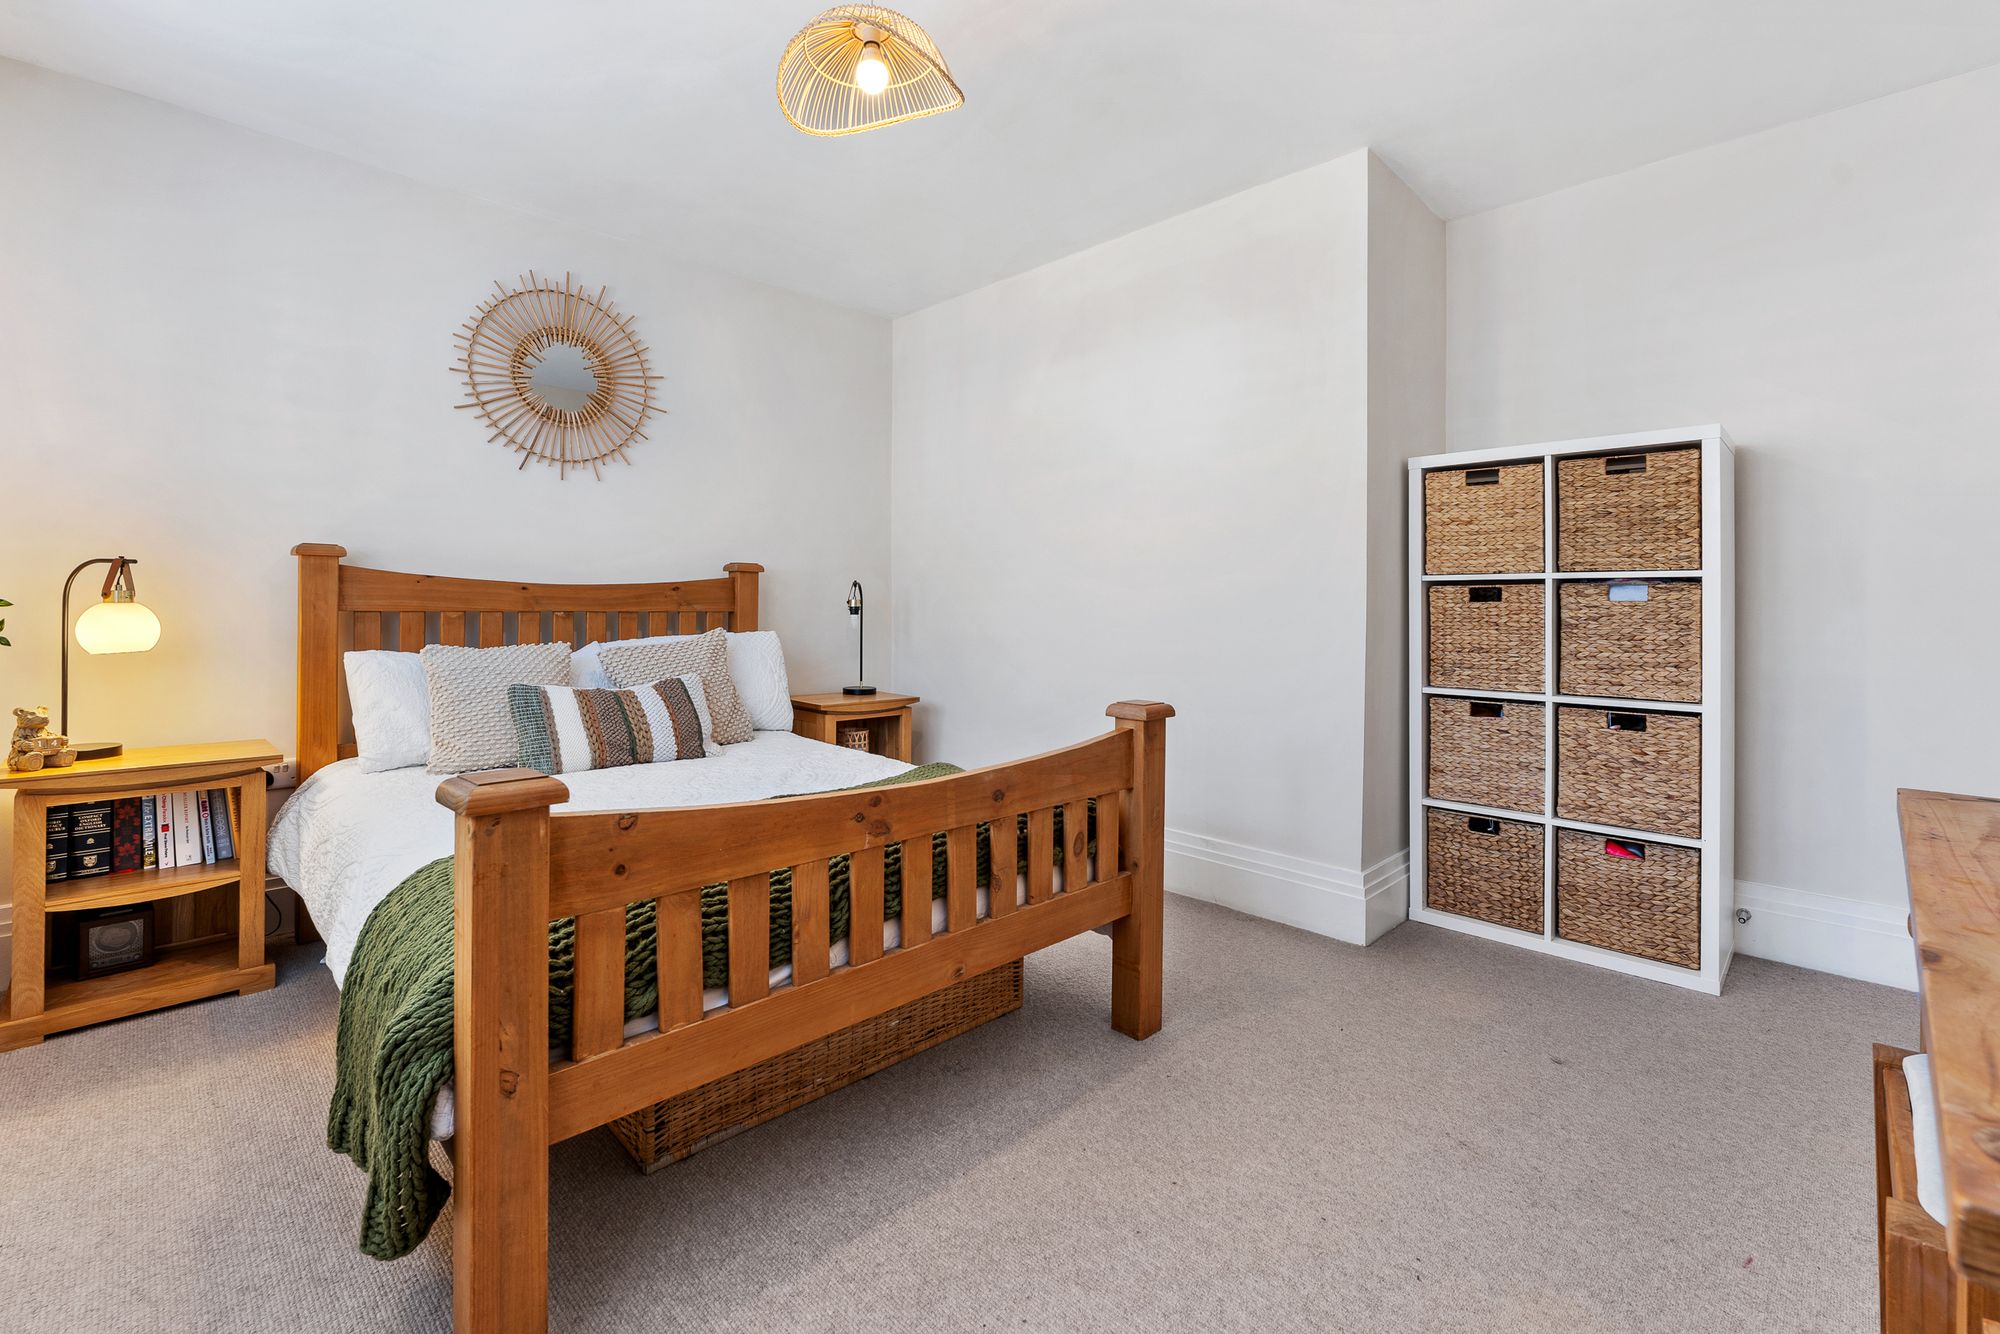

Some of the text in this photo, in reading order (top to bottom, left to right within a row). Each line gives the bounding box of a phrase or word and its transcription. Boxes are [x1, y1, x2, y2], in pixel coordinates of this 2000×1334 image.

[143, 801, 153, 813] The
[144, 815, 153, 838] EXTRA
[144, 838, 154, 855] MILE
